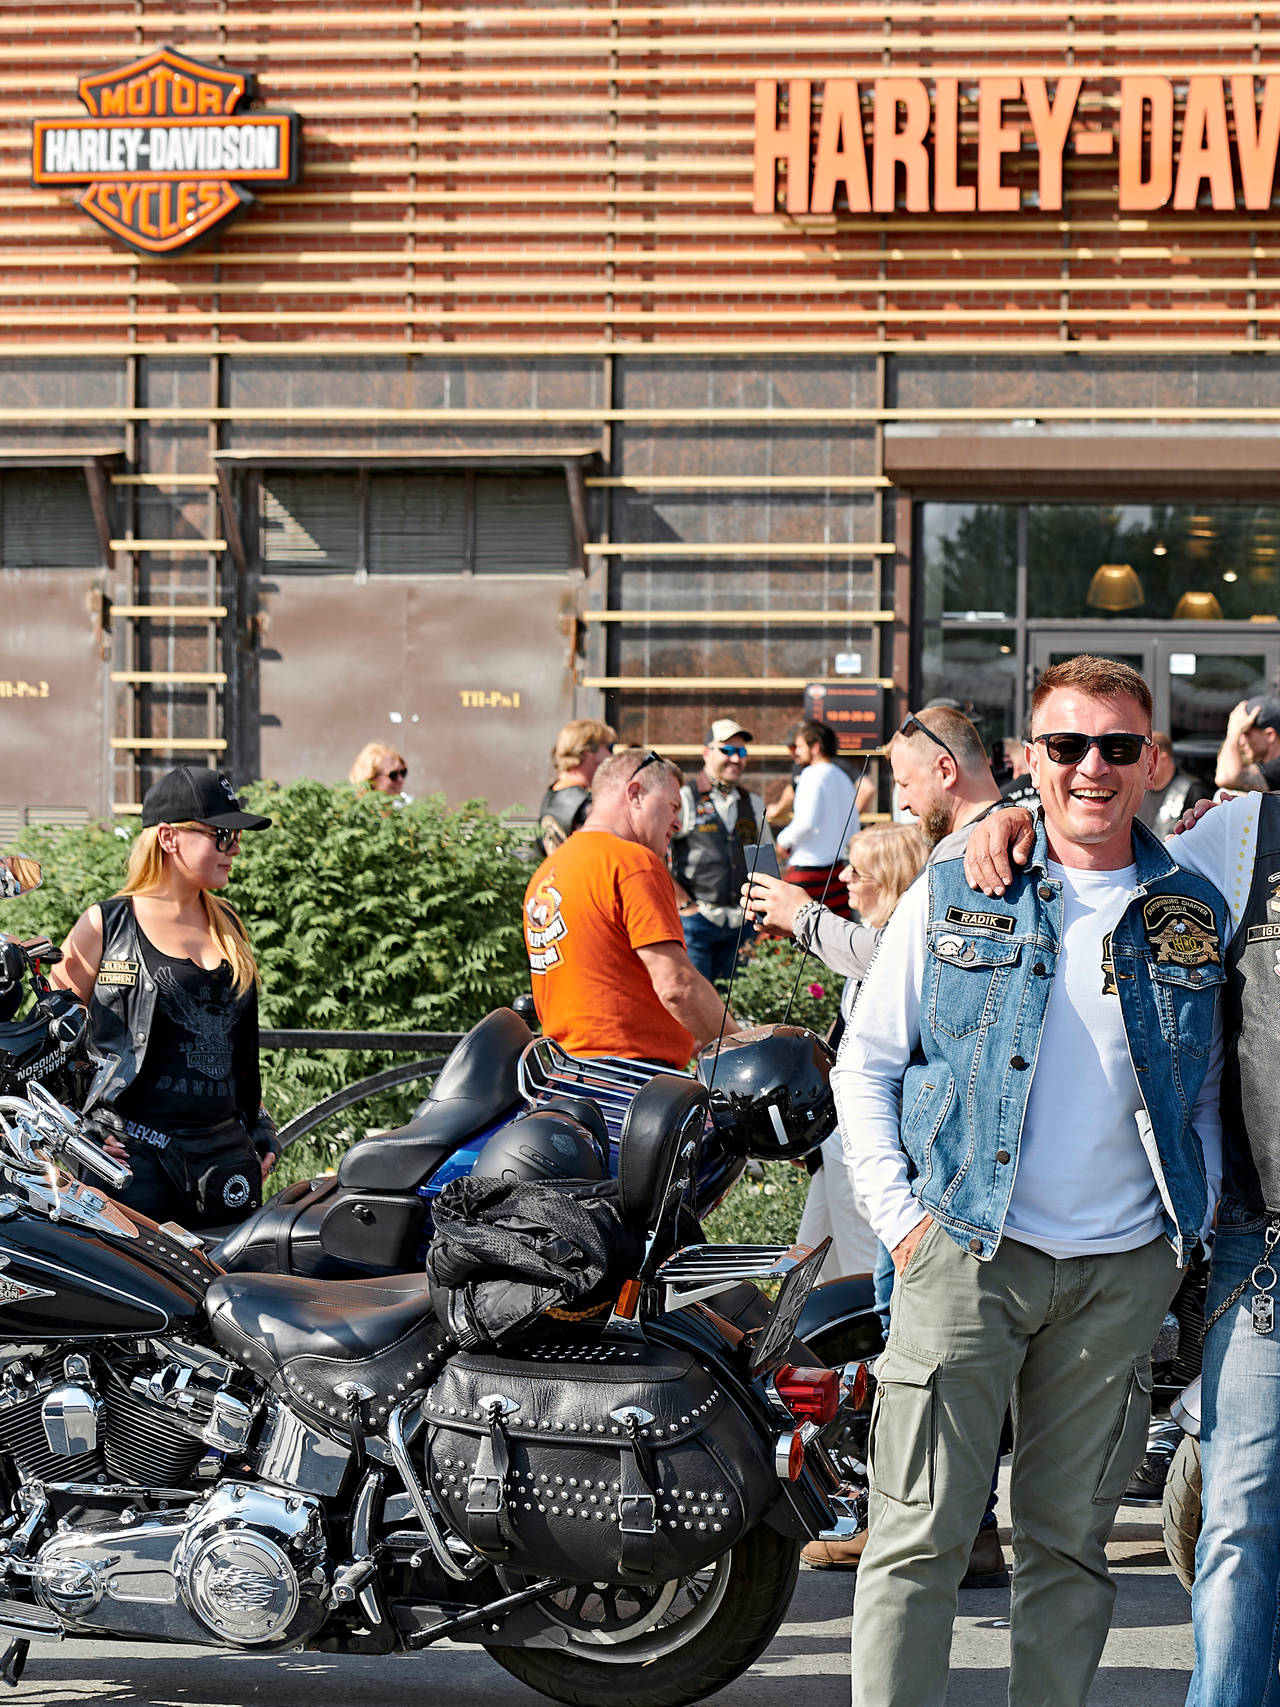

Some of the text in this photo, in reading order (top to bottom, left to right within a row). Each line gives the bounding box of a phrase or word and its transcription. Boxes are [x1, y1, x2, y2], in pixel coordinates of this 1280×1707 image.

[101, 64, 223, 117] MOTOR
[44, 124, 278, 173] HARLEY-DAVIDSON
[97, 180, 221, 239] CYCLES
[1163, 905, 1187, 913] RUSSIA
[1181, 899, 1209, 917] CHAPTER
[960, 912, 1000, 927] RADIK
[104, 962, 131, 971] ELENA
[101, 973, 132, 984] TYUMEN
[15, 1048, 60, 1081] AVIDSON
